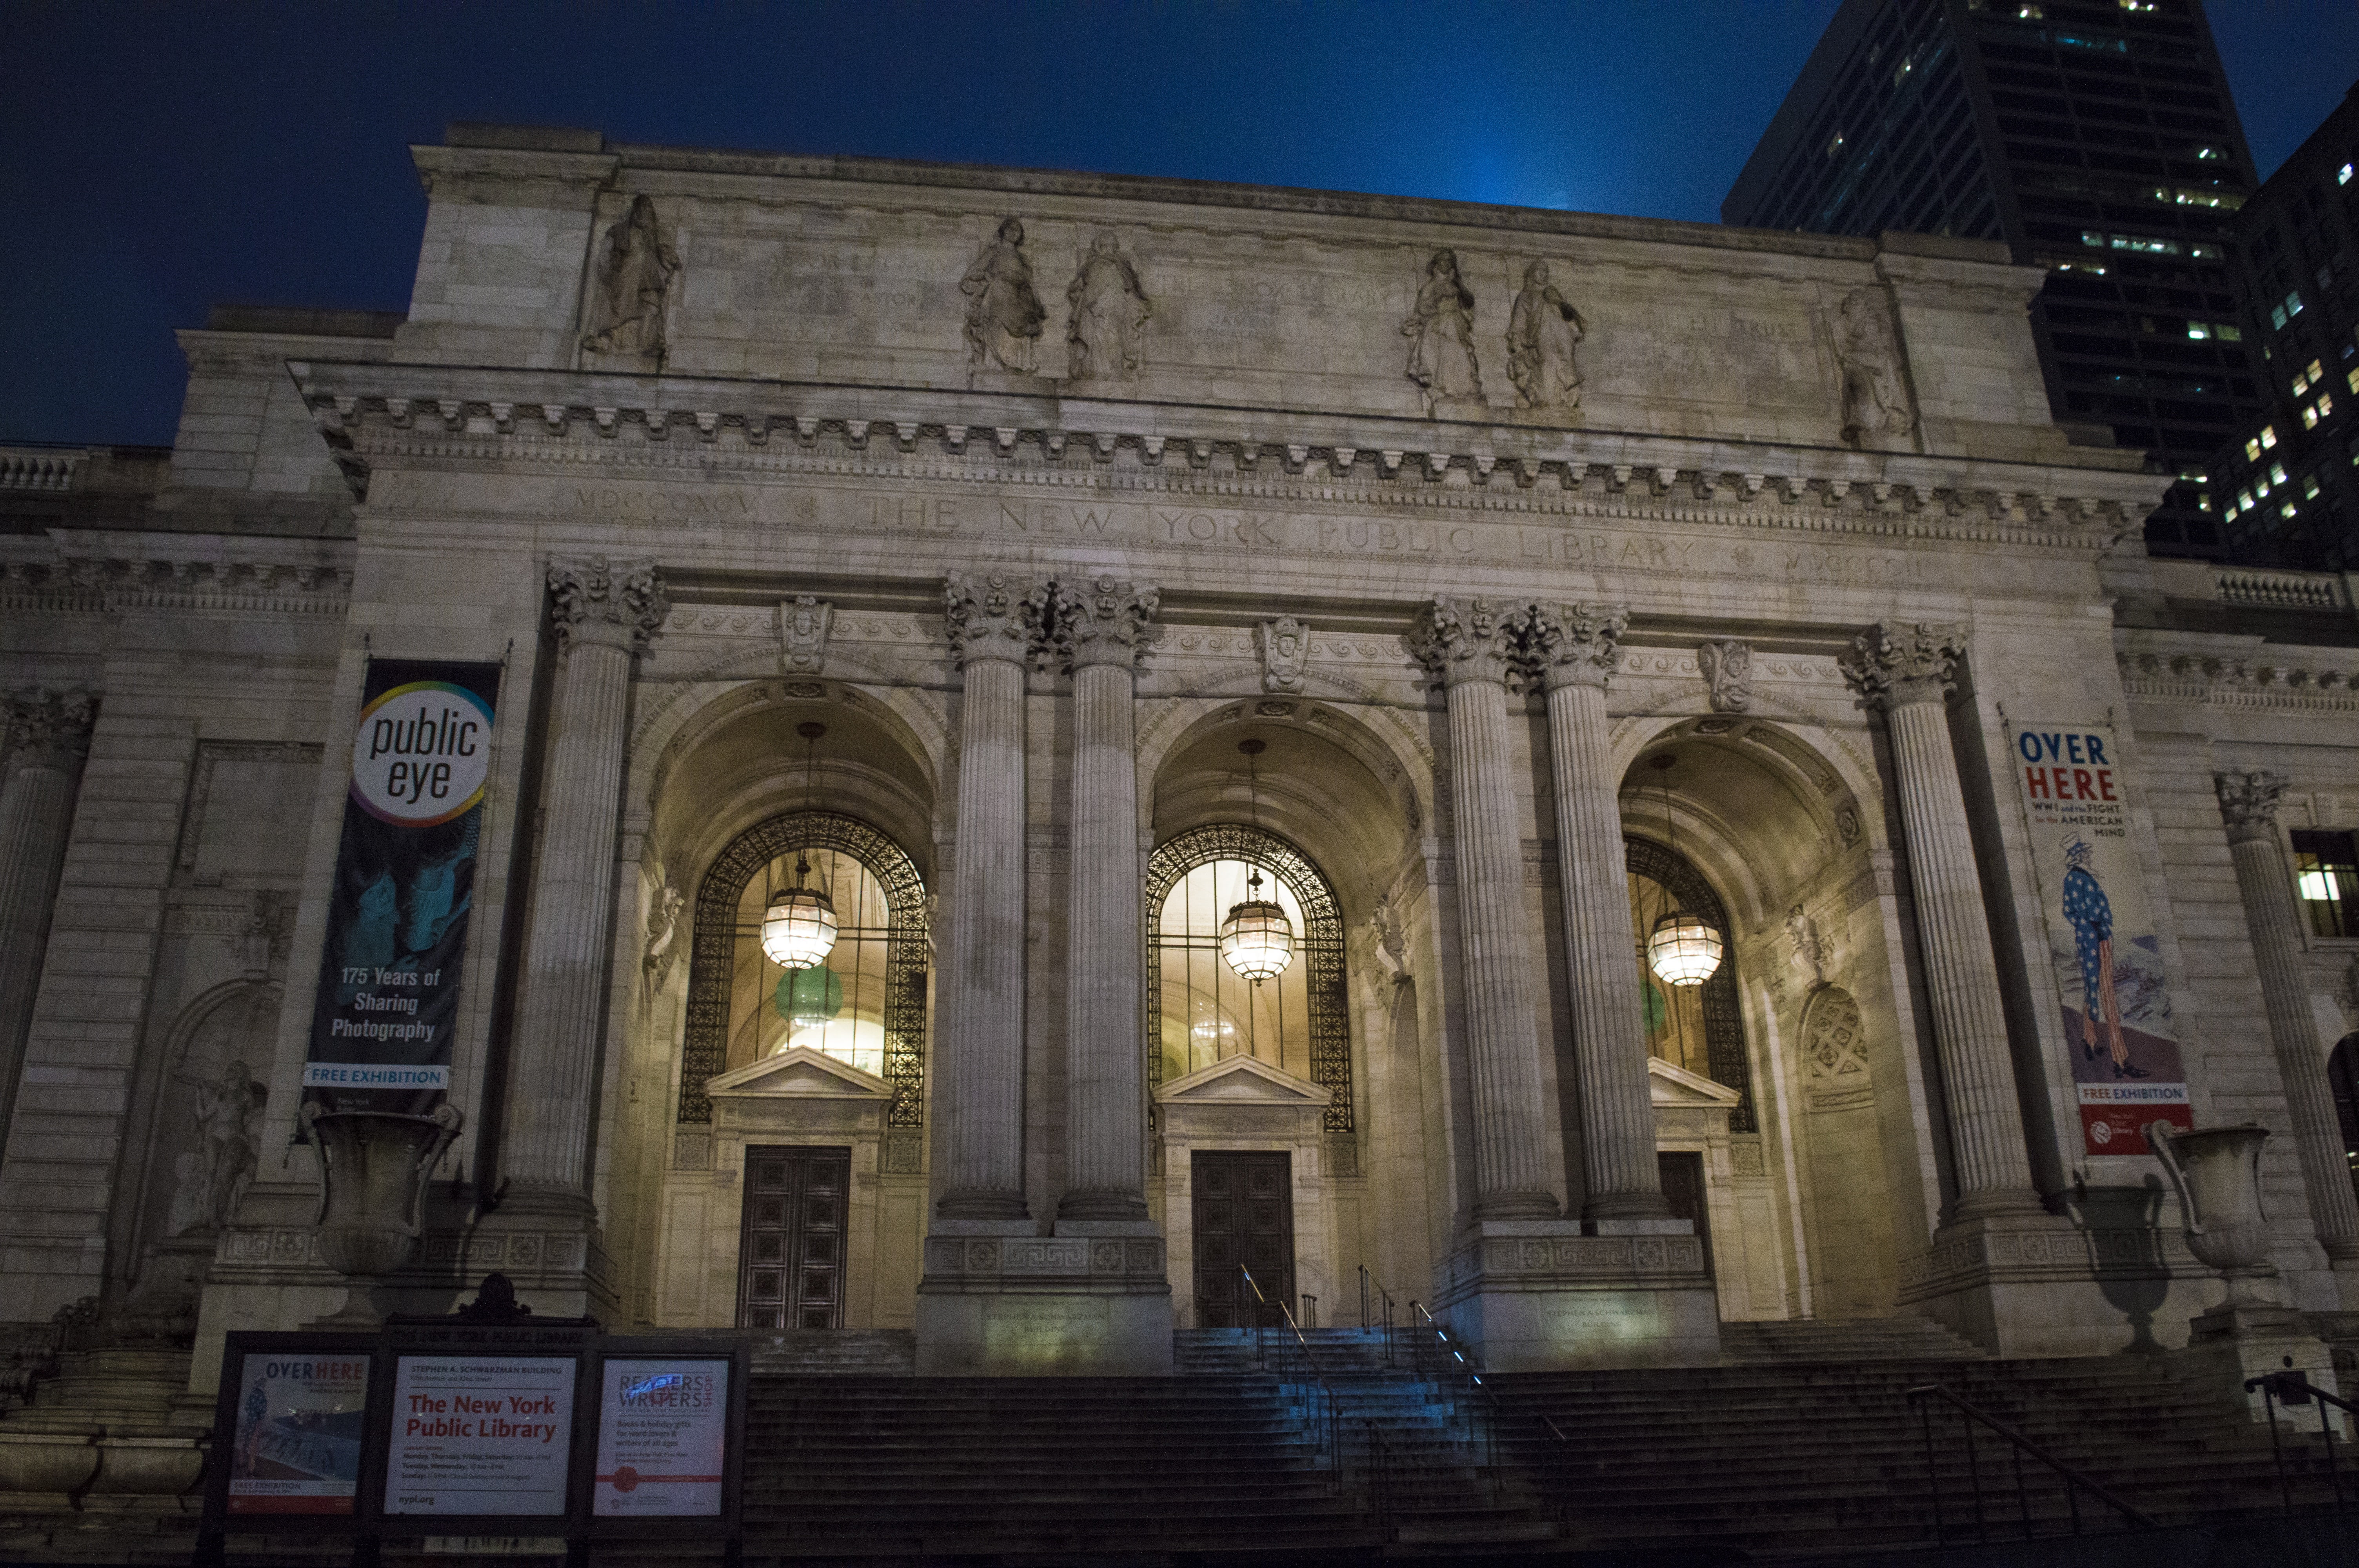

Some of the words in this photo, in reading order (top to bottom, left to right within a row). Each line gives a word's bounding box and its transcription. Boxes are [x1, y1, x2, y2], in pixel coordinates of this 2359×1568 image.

[865, 495, 961, 529] THE
[1000, 502, 1112, 533] NEW
[1157, 512, 1280, 546] YORK
[1315, 518, 1476, 555] PUBLIC
[1519, 529, 1694, 568] LIBRARY
[370, 707, 478, 760] public
[2020, 732, 2109, 764] OVER
[387, 762, 450, 804] eye
[2025, 767, 2117, 801] HERE
[2087, 804, 2120, 814] FIGHT
[2061, 816, 2123, 825] AMERICAN
[2094, 828, 2125, 837] MIND
[342, 967, 369, 984] 175
[375, 967, 418, 985] Years
[424, 968, 442, 986] of
[354, 992, 419, 1015] Sharing
[332, 1019, 435, 1042] Photography
[312, 1069, 348, 1082] FREE
[353, 1070, 440, 1083] EXHIBITION
[2083, 1089, 2110, 1098] FREE
[2114, 1089, 2183, 1098] EXHIBITION
[267, 1362, 313, 1379] OVER
[316, 1363, 363, 1380] HERE
[620, 1376, 704, 1391] REERS
[409, 1394, 447, 1413] The
[454, 1396, 502, 1413] New
[508, 1395, 556, 1414] York
[407, 1417, 473, 1436] Public
[479, 1418, 556, 1444] Library
[399, 1495, 434, 1505] nypl.org
